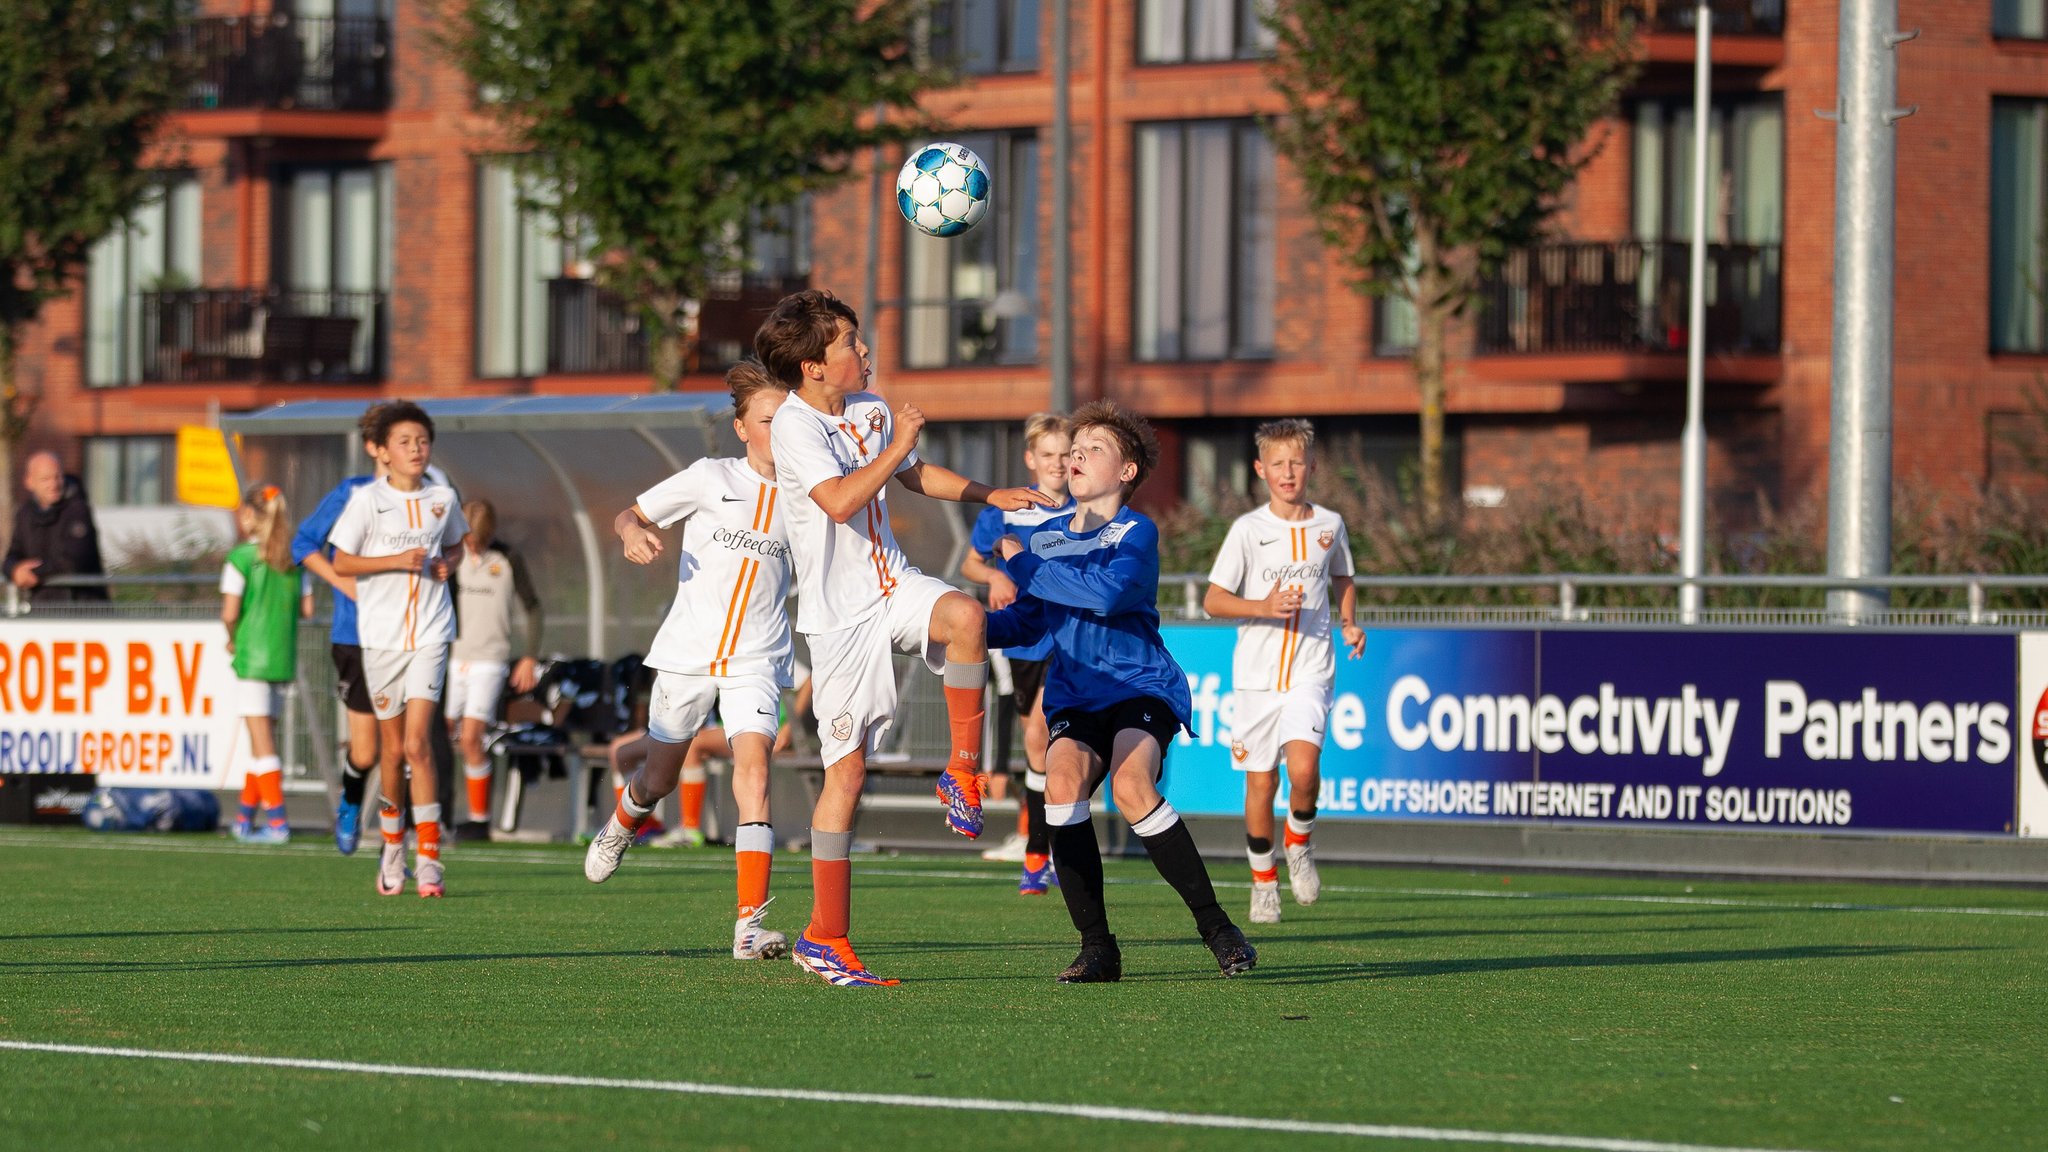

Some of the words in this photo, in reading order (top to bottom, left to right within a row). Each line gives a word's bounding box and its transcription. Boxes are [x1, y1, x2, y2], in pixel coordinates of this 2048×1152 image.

[127, 642, 212, 716] B.V.
[1765, 680, 2011, 763] Partners
[1360, 779, 1490, 815] OFFSHORE
[1493, 782, 1616, 818] INTERNET
[1616, 784, 1673, 820] AND
[1677, 785, 1702, 821] IT
[1704, 786, 1852, 825] SOLUTIONS
